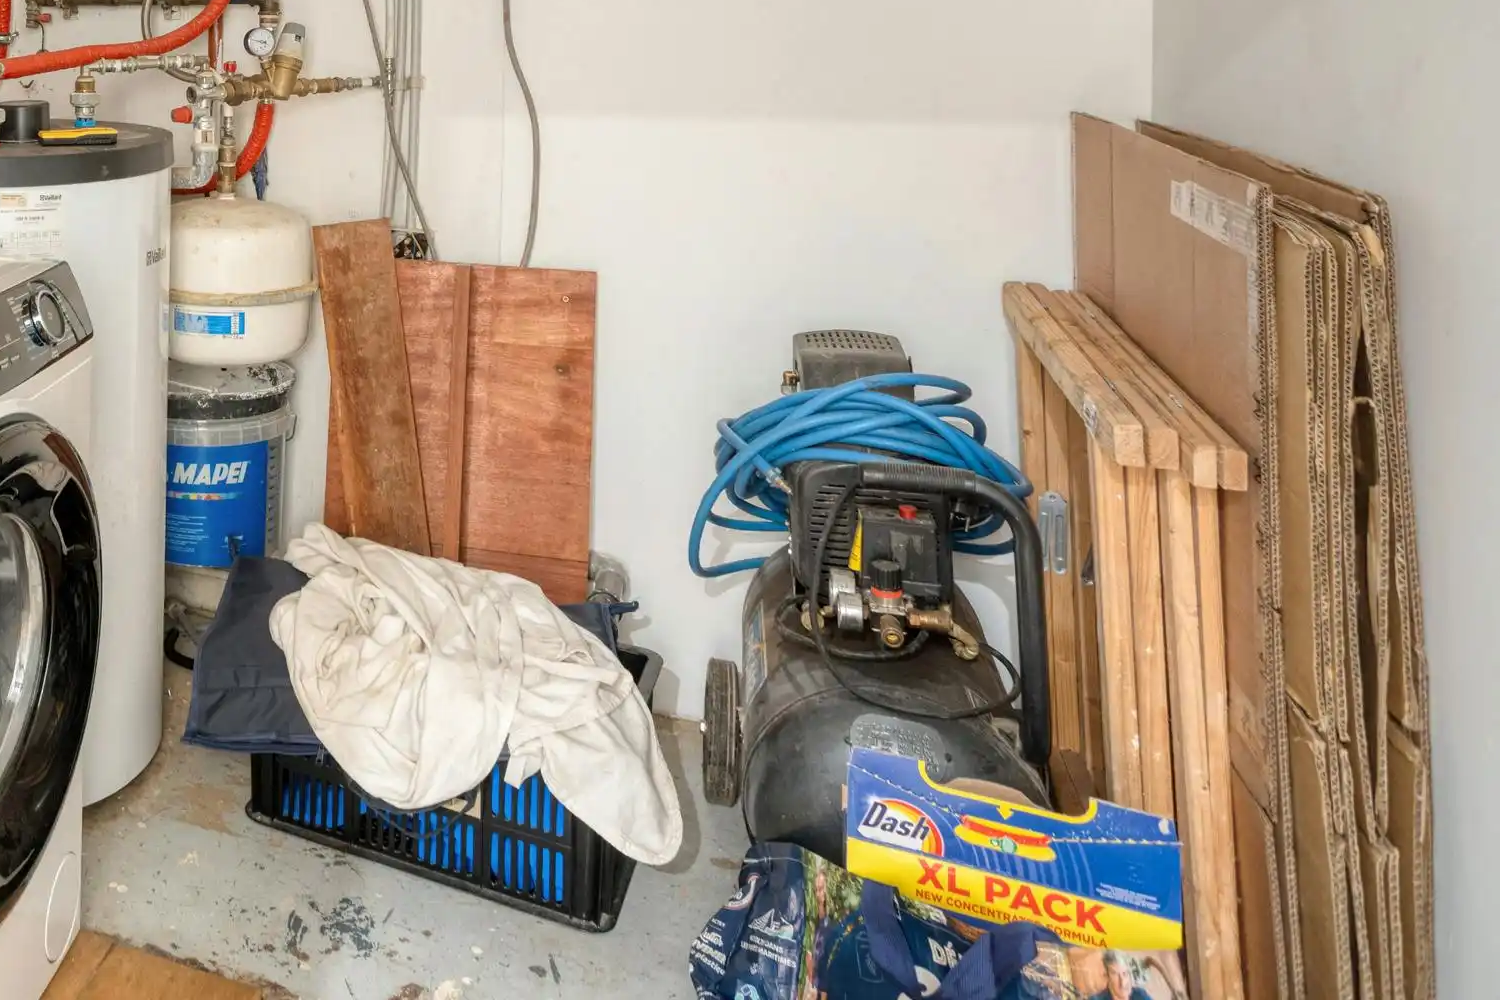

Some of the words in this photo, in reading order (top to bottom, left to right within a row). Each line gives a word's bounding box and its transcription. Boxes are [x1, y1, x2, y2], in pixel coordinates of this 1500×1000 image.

[173, 461, 249, 485] MAPEI
[863, 801, 931, 841] Dash
[915, 888, 943, 903] NEW
[946, 897, 1041, 925] CONCENTRA
[917, 857, 971, 898] XL
[984, 875, 1108, 935] PACK
